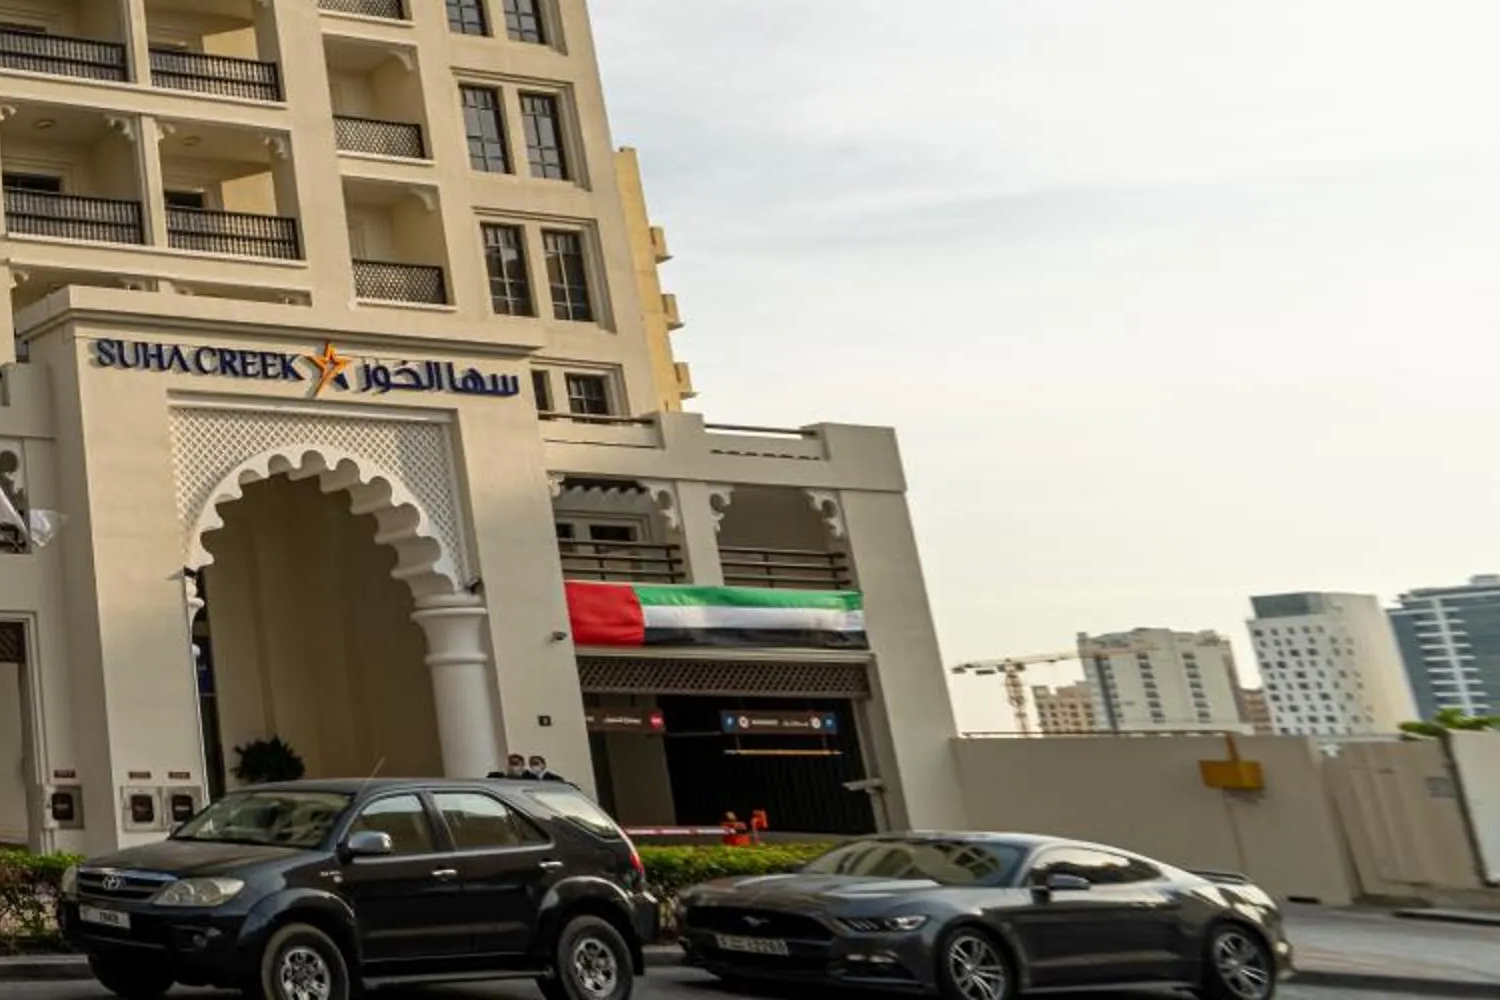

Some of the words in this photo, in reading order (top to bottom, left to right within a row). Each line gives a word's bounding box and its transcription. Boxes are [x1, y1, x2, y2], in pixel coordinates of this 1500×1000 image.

[97, 338, 190, 373] SUHA
[194, 346, 305, 381] CREEK
[360, 359, 445, 394] الخور
[448, 361, 519, 397] سها
